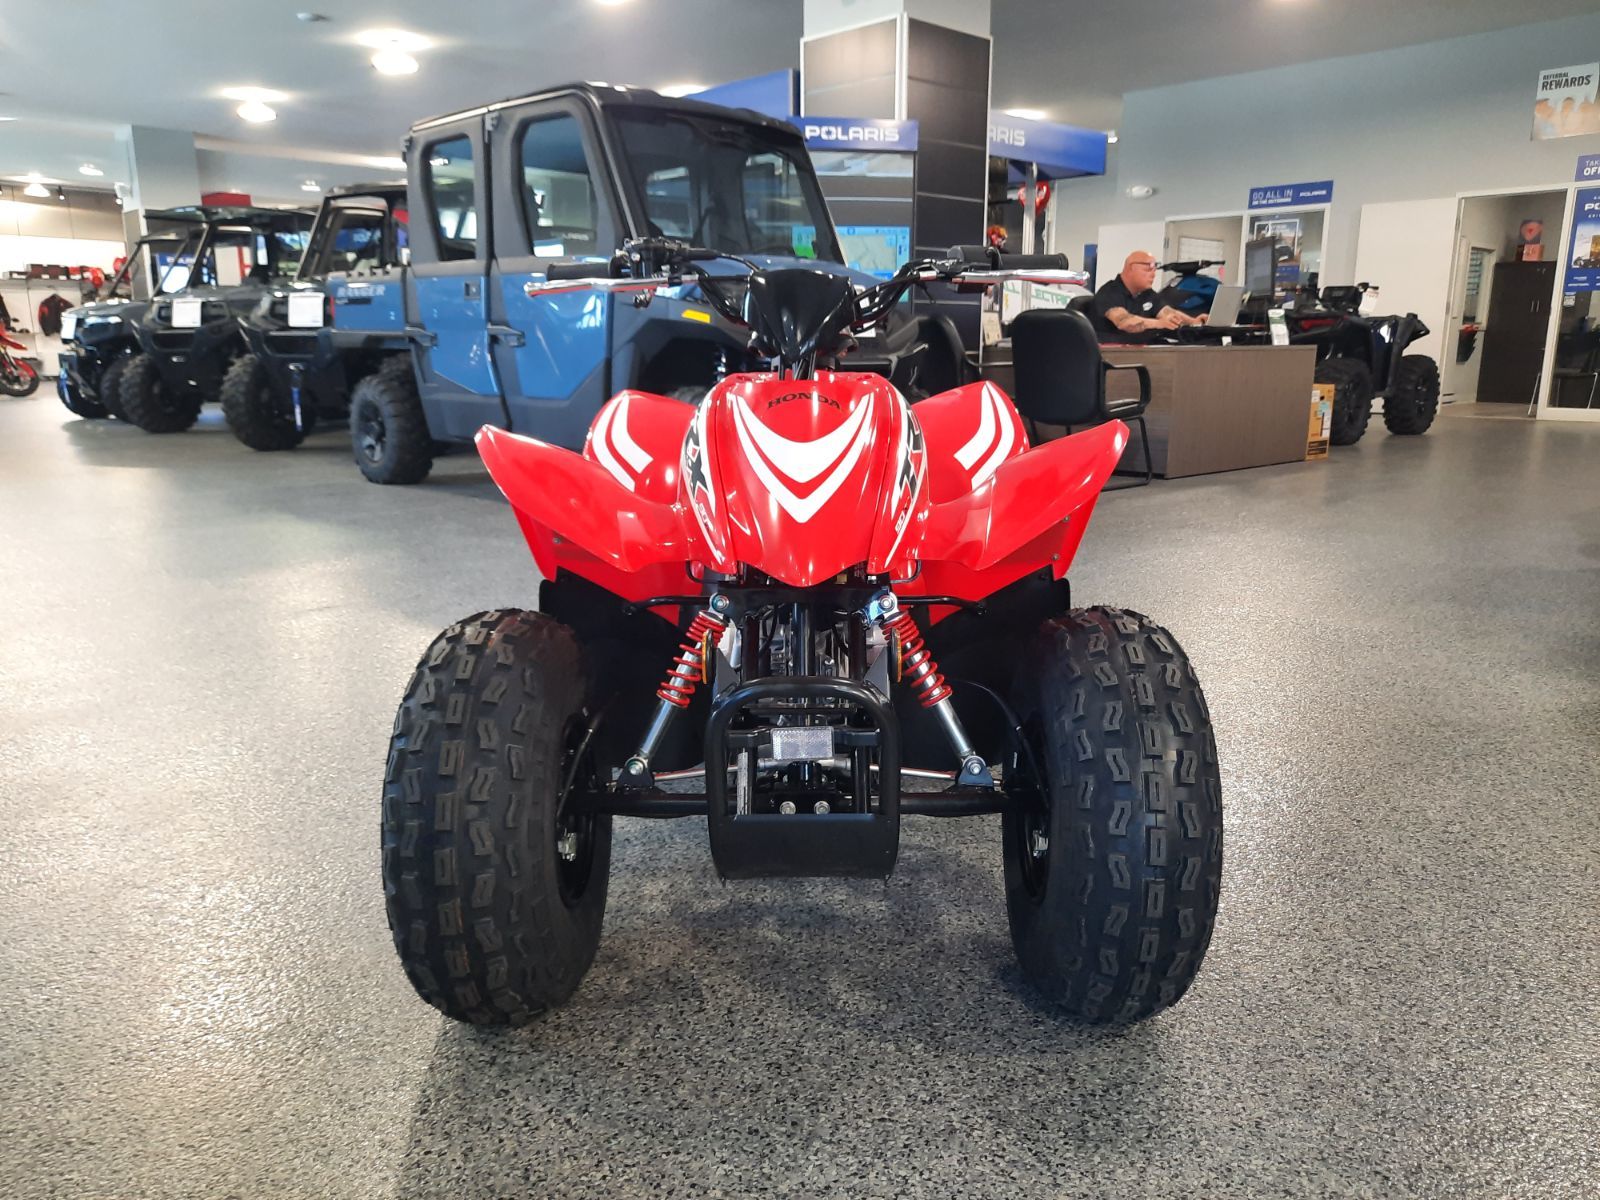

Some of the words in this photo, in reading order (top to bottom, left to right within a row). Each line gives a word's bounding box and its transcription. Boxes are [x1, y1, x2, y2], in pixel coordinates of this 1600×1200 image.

[1541, 75, 1592, 91] REWARDS
[804, 125, 900, 142] POLARIS
[768, 392, 841, 409] HONDA
